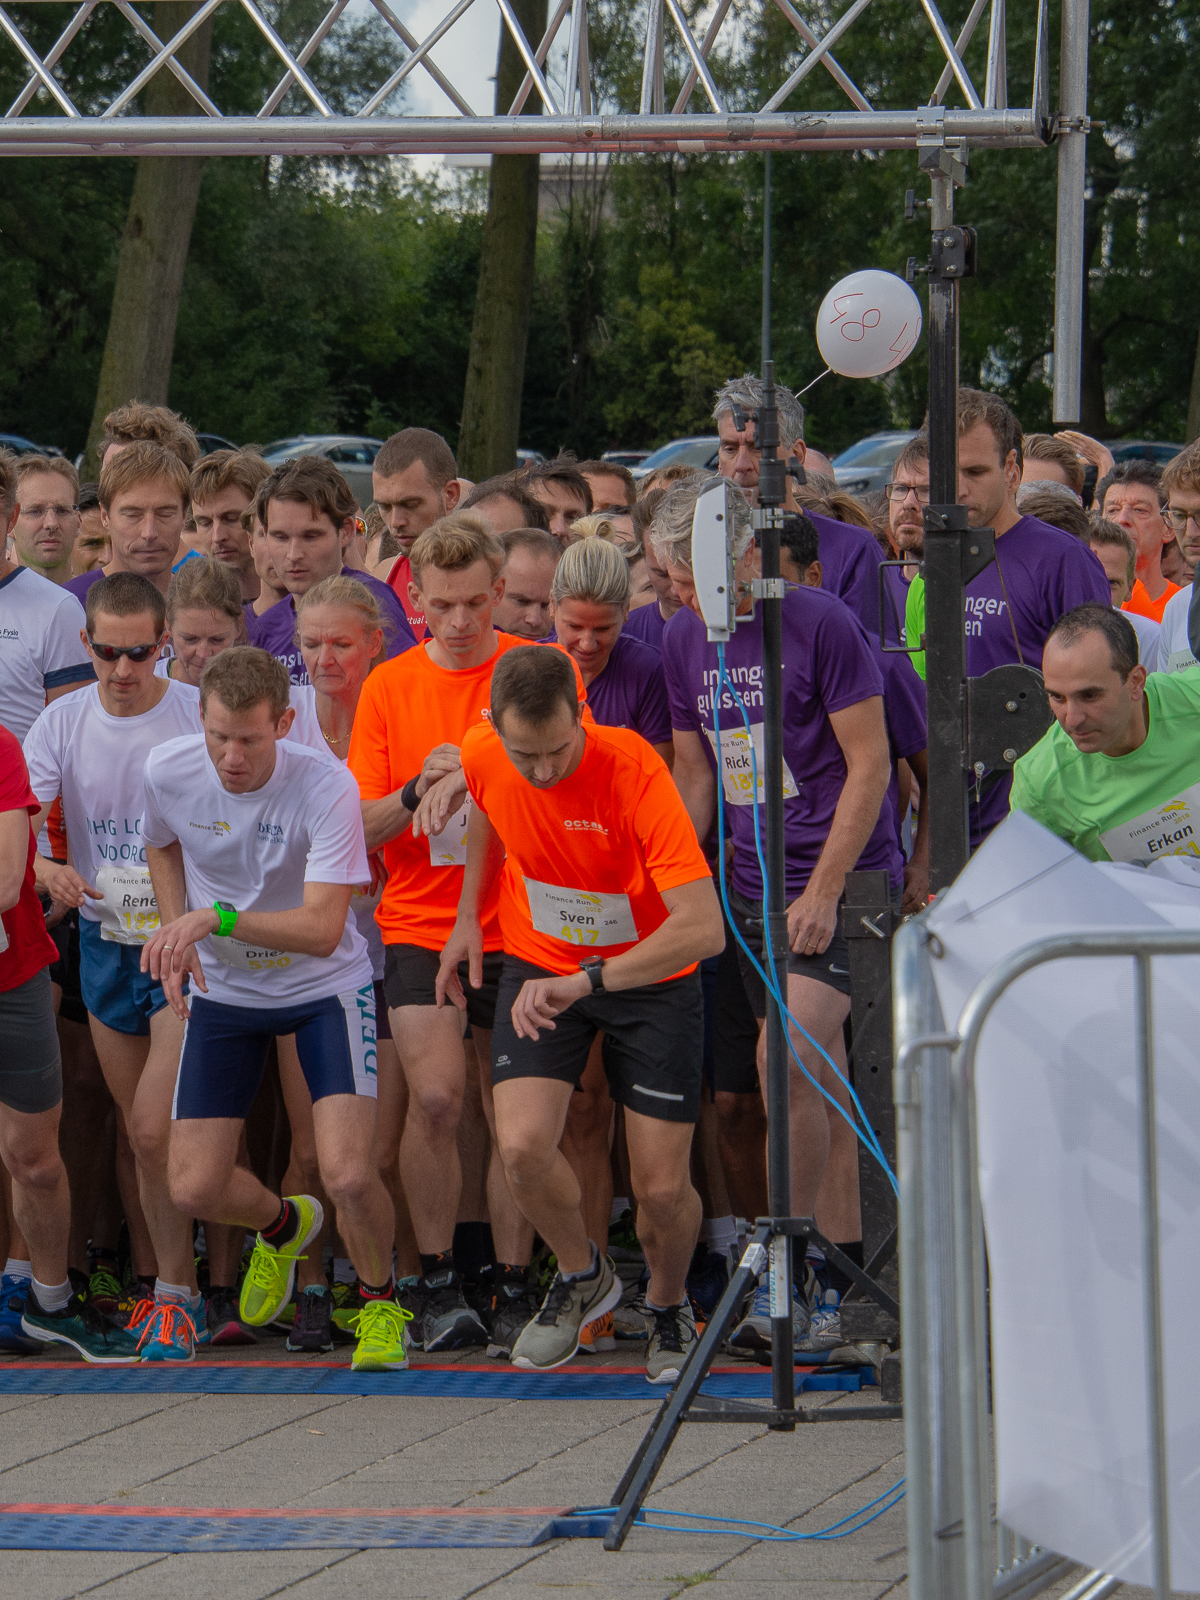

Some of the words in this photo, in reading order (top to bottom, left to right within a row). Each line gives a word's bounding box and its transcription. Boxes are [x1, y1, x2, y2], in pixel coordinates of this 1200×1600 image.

[725, 755, 751, 769] Rick
[189, 821, 211, 831] Finance
[1128, 820, 1160, 839] Finance
[1161, 811, 1179, 823] Run
[1146, 824, 1194, 853] Erkan
[112, 877, 139, 885] Finance
[545, 892, 574, 904] Finance
[576, 898, 592, 906] Run
[122, 911, 160, 930] 199
[559, 910, 595, 925] Sven
[561, 925, 599, 944] 417
[249, 956, 291, 970] 520
